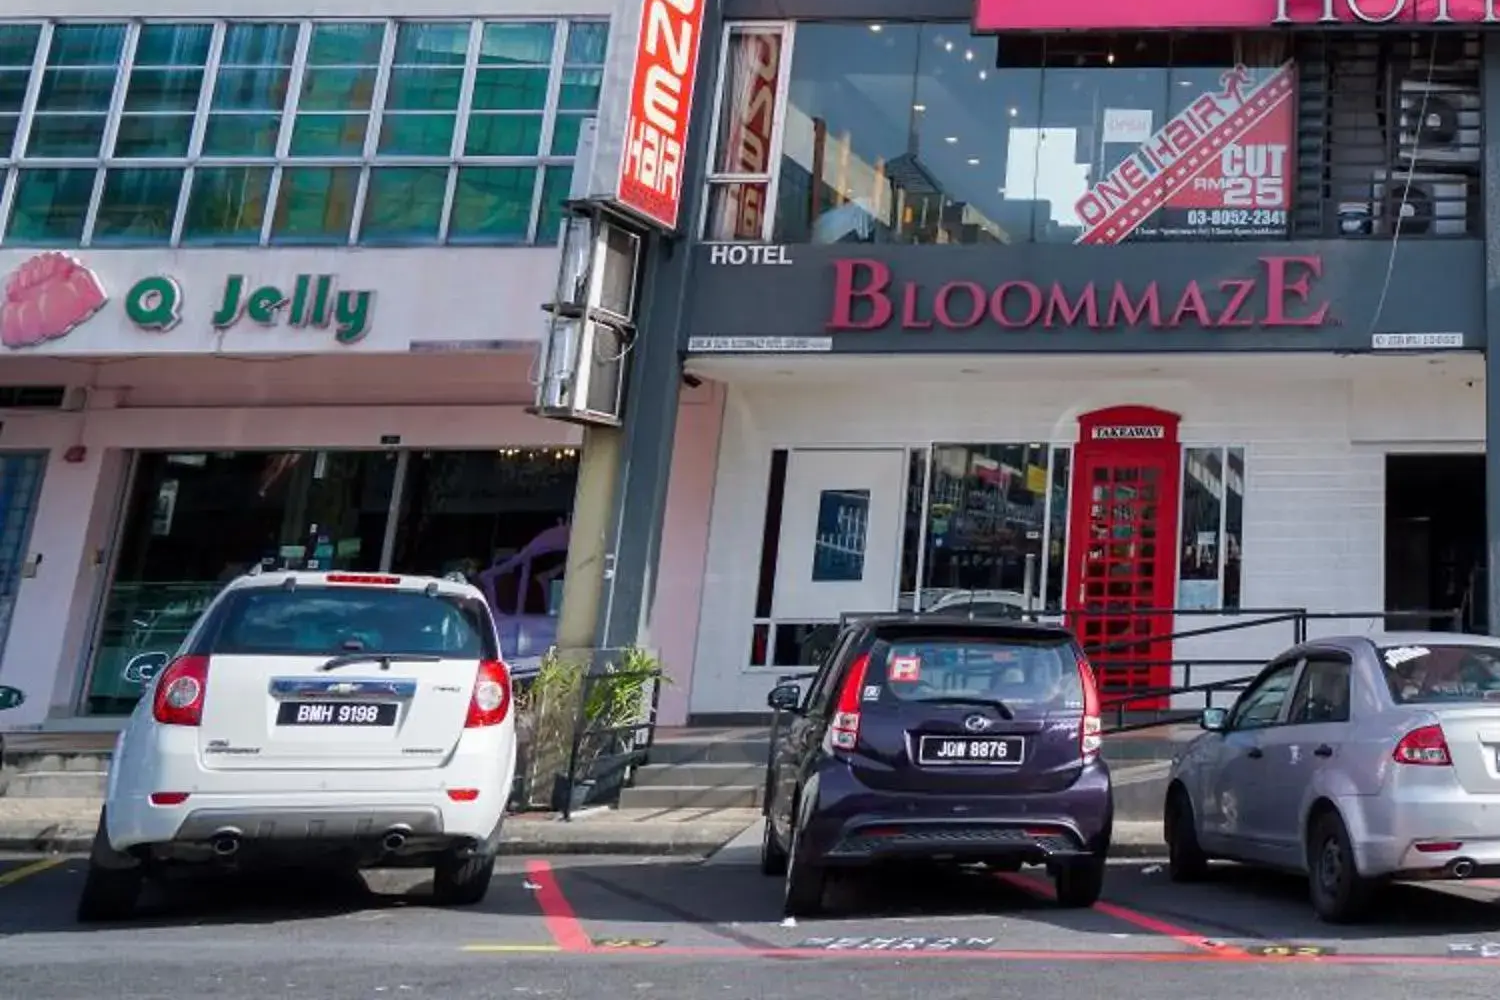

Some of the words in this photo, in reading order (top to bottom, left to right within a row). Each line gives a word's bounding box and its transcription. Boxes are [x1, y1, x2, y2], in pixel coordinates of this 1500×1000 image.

[1221, 144, 1287, 177] CUT
[1223, 178, 1284, 206] 25
[710, 245, 793, 265] HOTEL
[125, 275, 183, 331] Q
[212, 274, 377, 344] Jelly
[1096, 427, 1161, 438] TAKEAWAY
[297, 706, 333, 722] BMH
[339, 706, 379, 722] 9198
